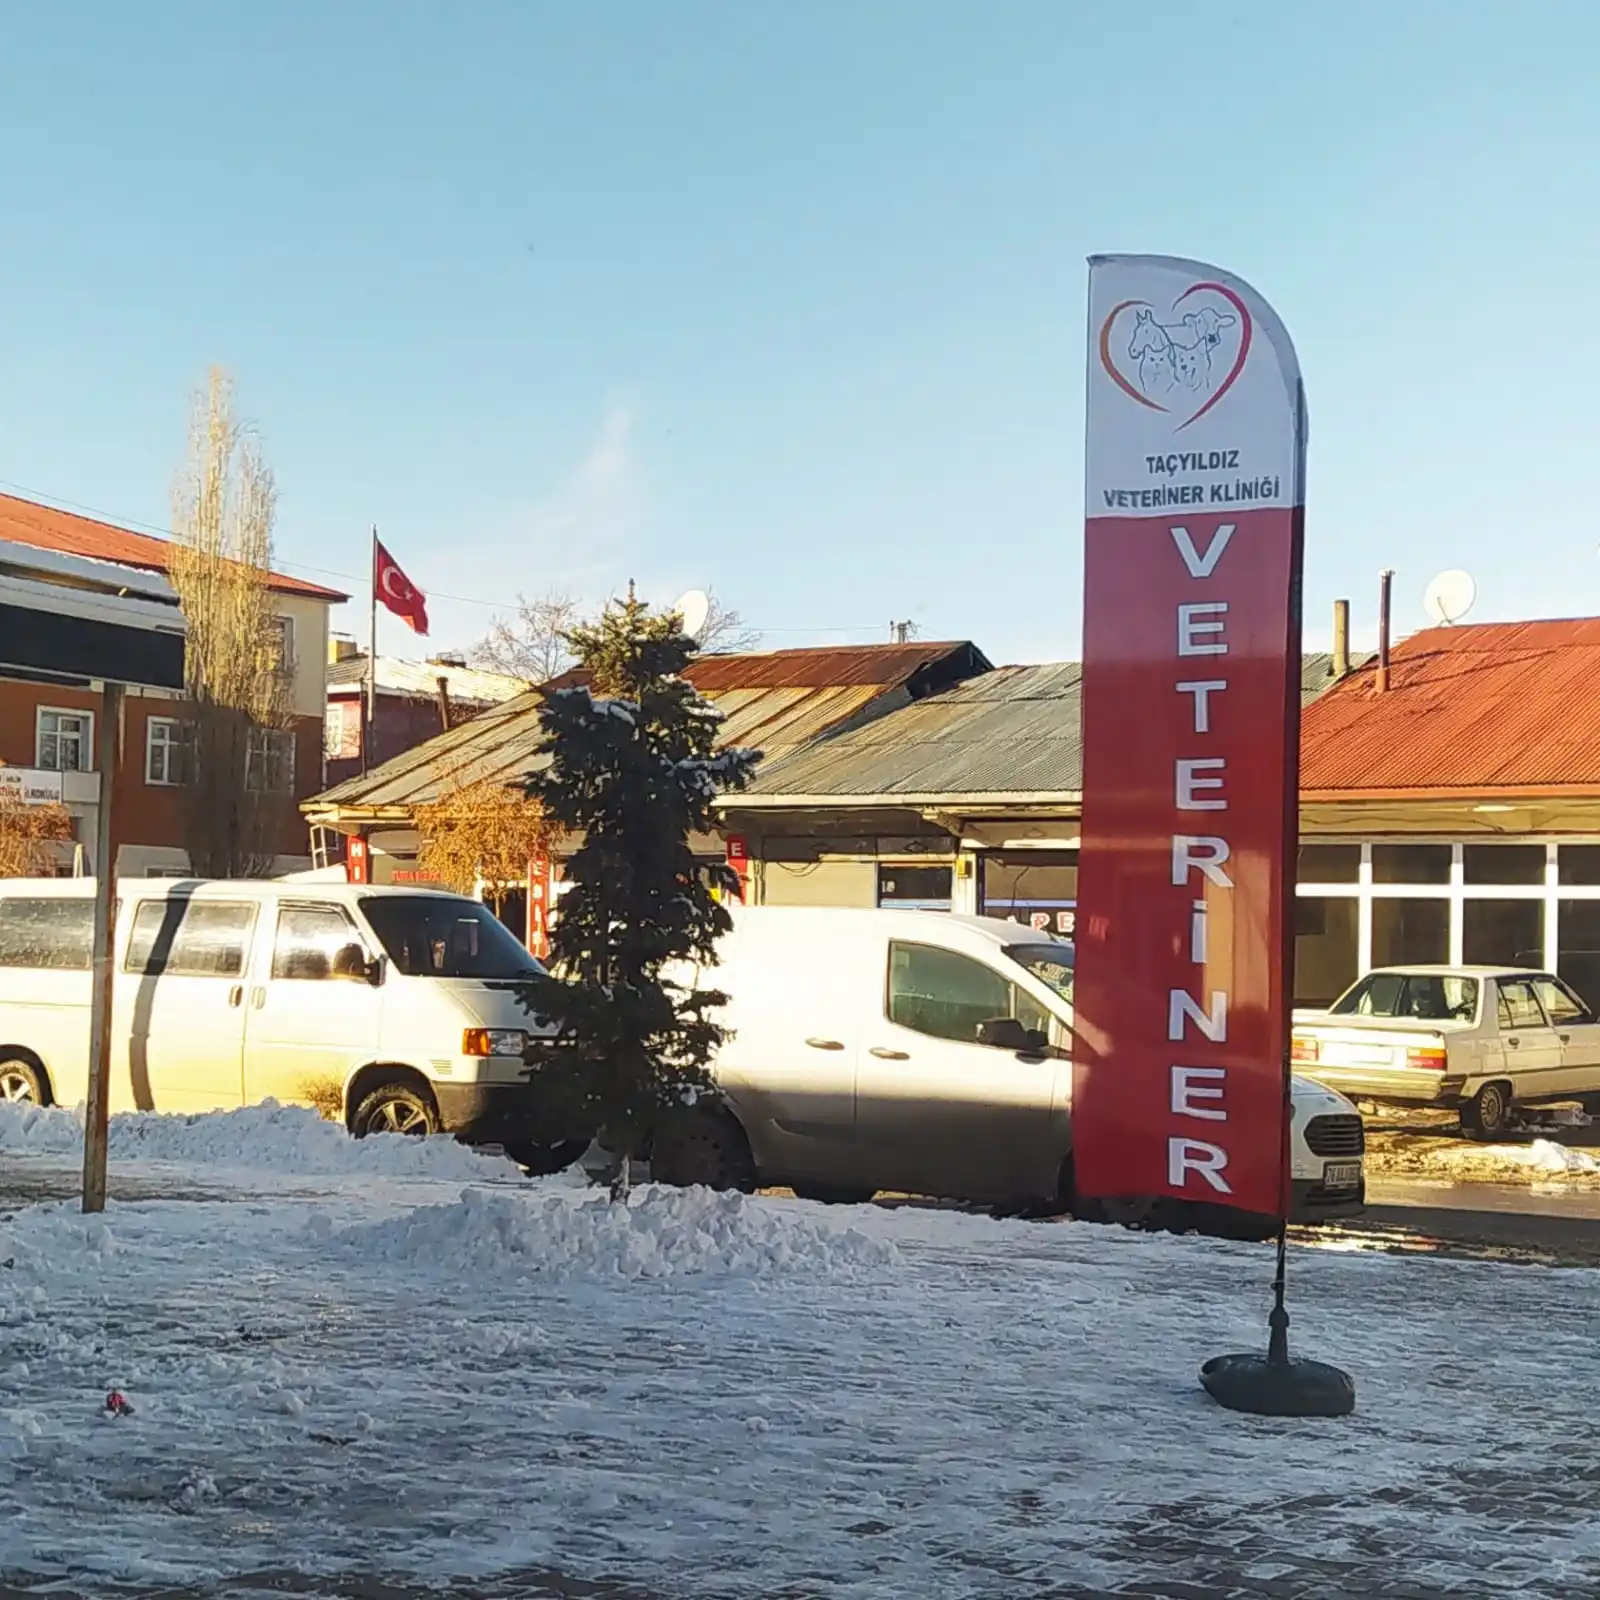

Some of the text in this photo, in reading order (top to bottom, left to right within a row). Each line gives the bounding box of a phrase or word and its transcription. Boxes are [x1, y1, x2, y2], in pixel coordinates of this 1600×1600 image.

[1146, 450, 1240, 477] TAÇYILDIZ
[1103, 475, 1280, 509] VETERİNER KLİNİĞİ
[1167, 524, 1237, 1194] VETERİNER
